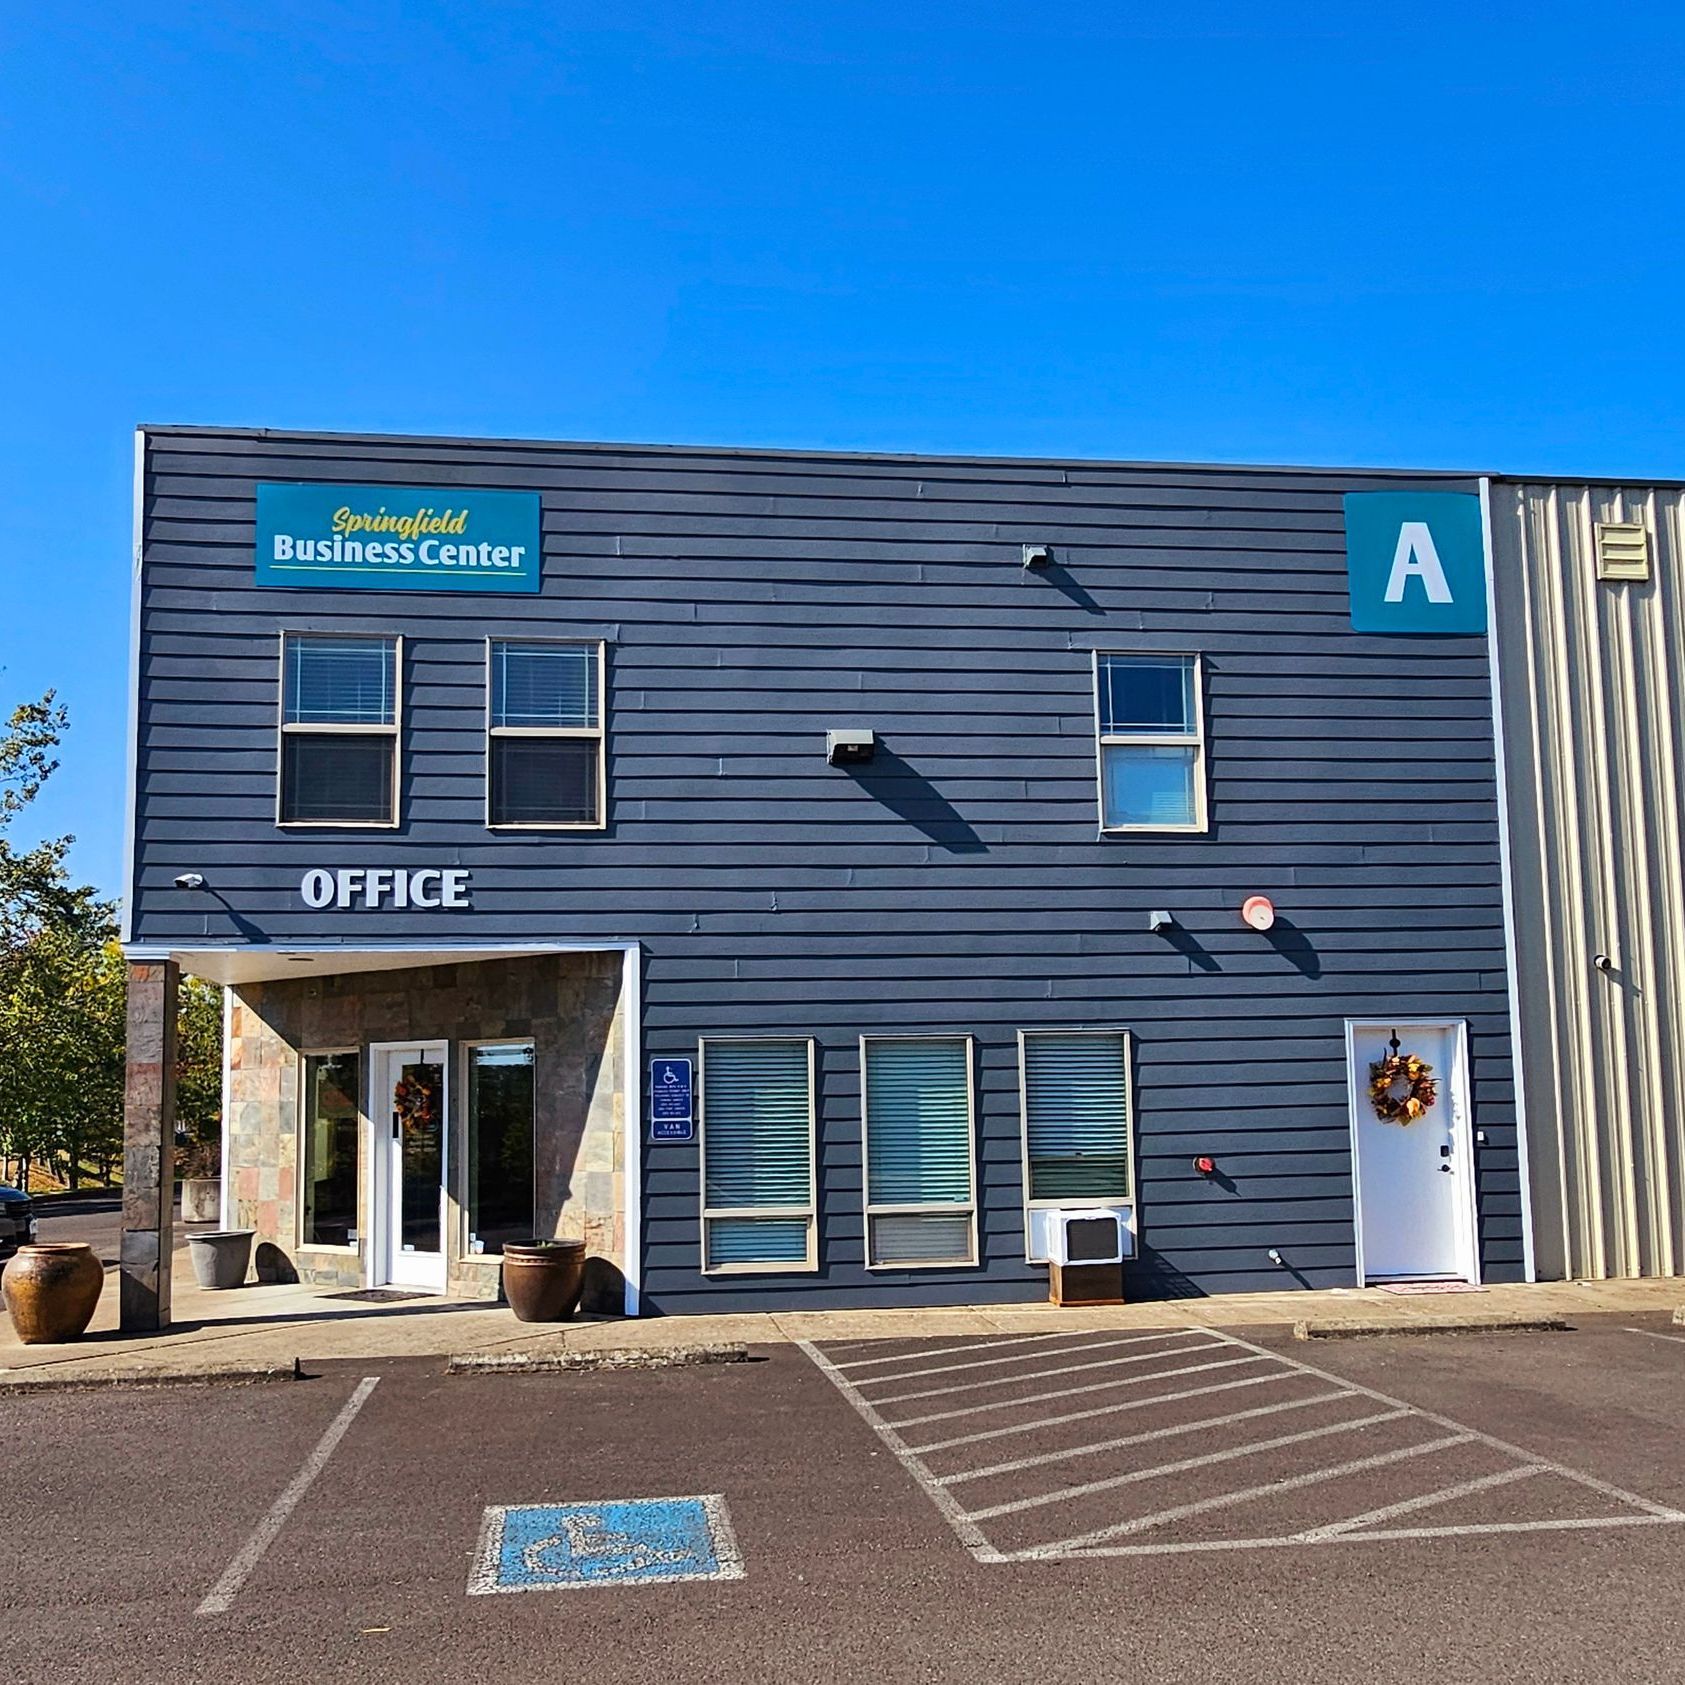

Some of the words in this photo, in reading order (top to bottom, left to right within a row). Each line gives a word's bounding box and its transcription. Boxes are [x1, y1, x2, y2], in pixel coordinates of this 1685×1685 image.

[332, 506, 469, 541] Springfield
[273, 534, 415, 564] Business
[418, 539, 526, 567] Center
[1384, 522, 1454, 603] A
[301, 868, 470, 908] OFFICE
